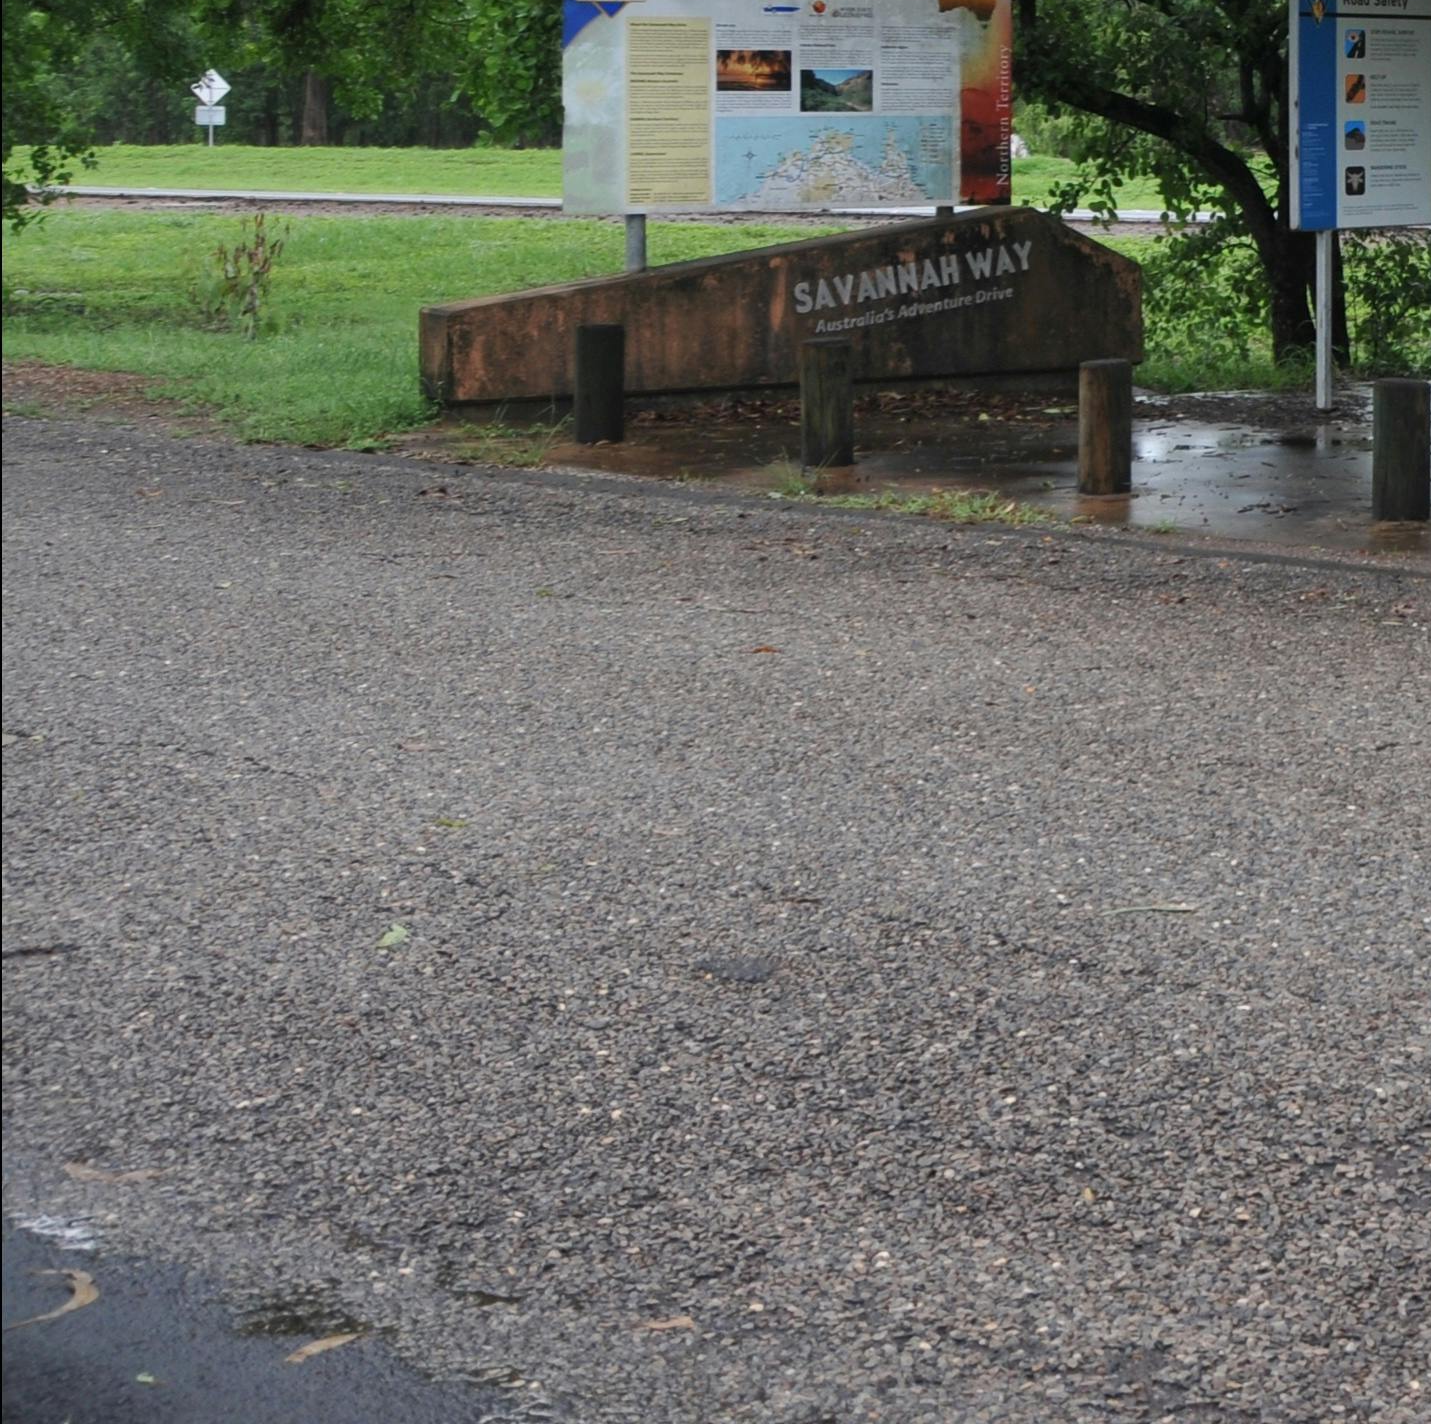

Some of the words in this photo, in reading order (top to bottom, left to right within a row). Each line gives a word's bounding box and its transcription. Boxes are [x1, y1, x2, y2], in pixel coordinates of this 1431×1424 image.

[996, 45, 1012, 112] Territory
[996, 117, 1009, 185] Northern
[794, 254, 960, 313] SAVANNAH
[965, 241, 1032, 280] WAY
[815, 308, 894, 333] Australia's
[898, 295, 973, 319] Adventure
[975, 287, 1013, 304] Drive
